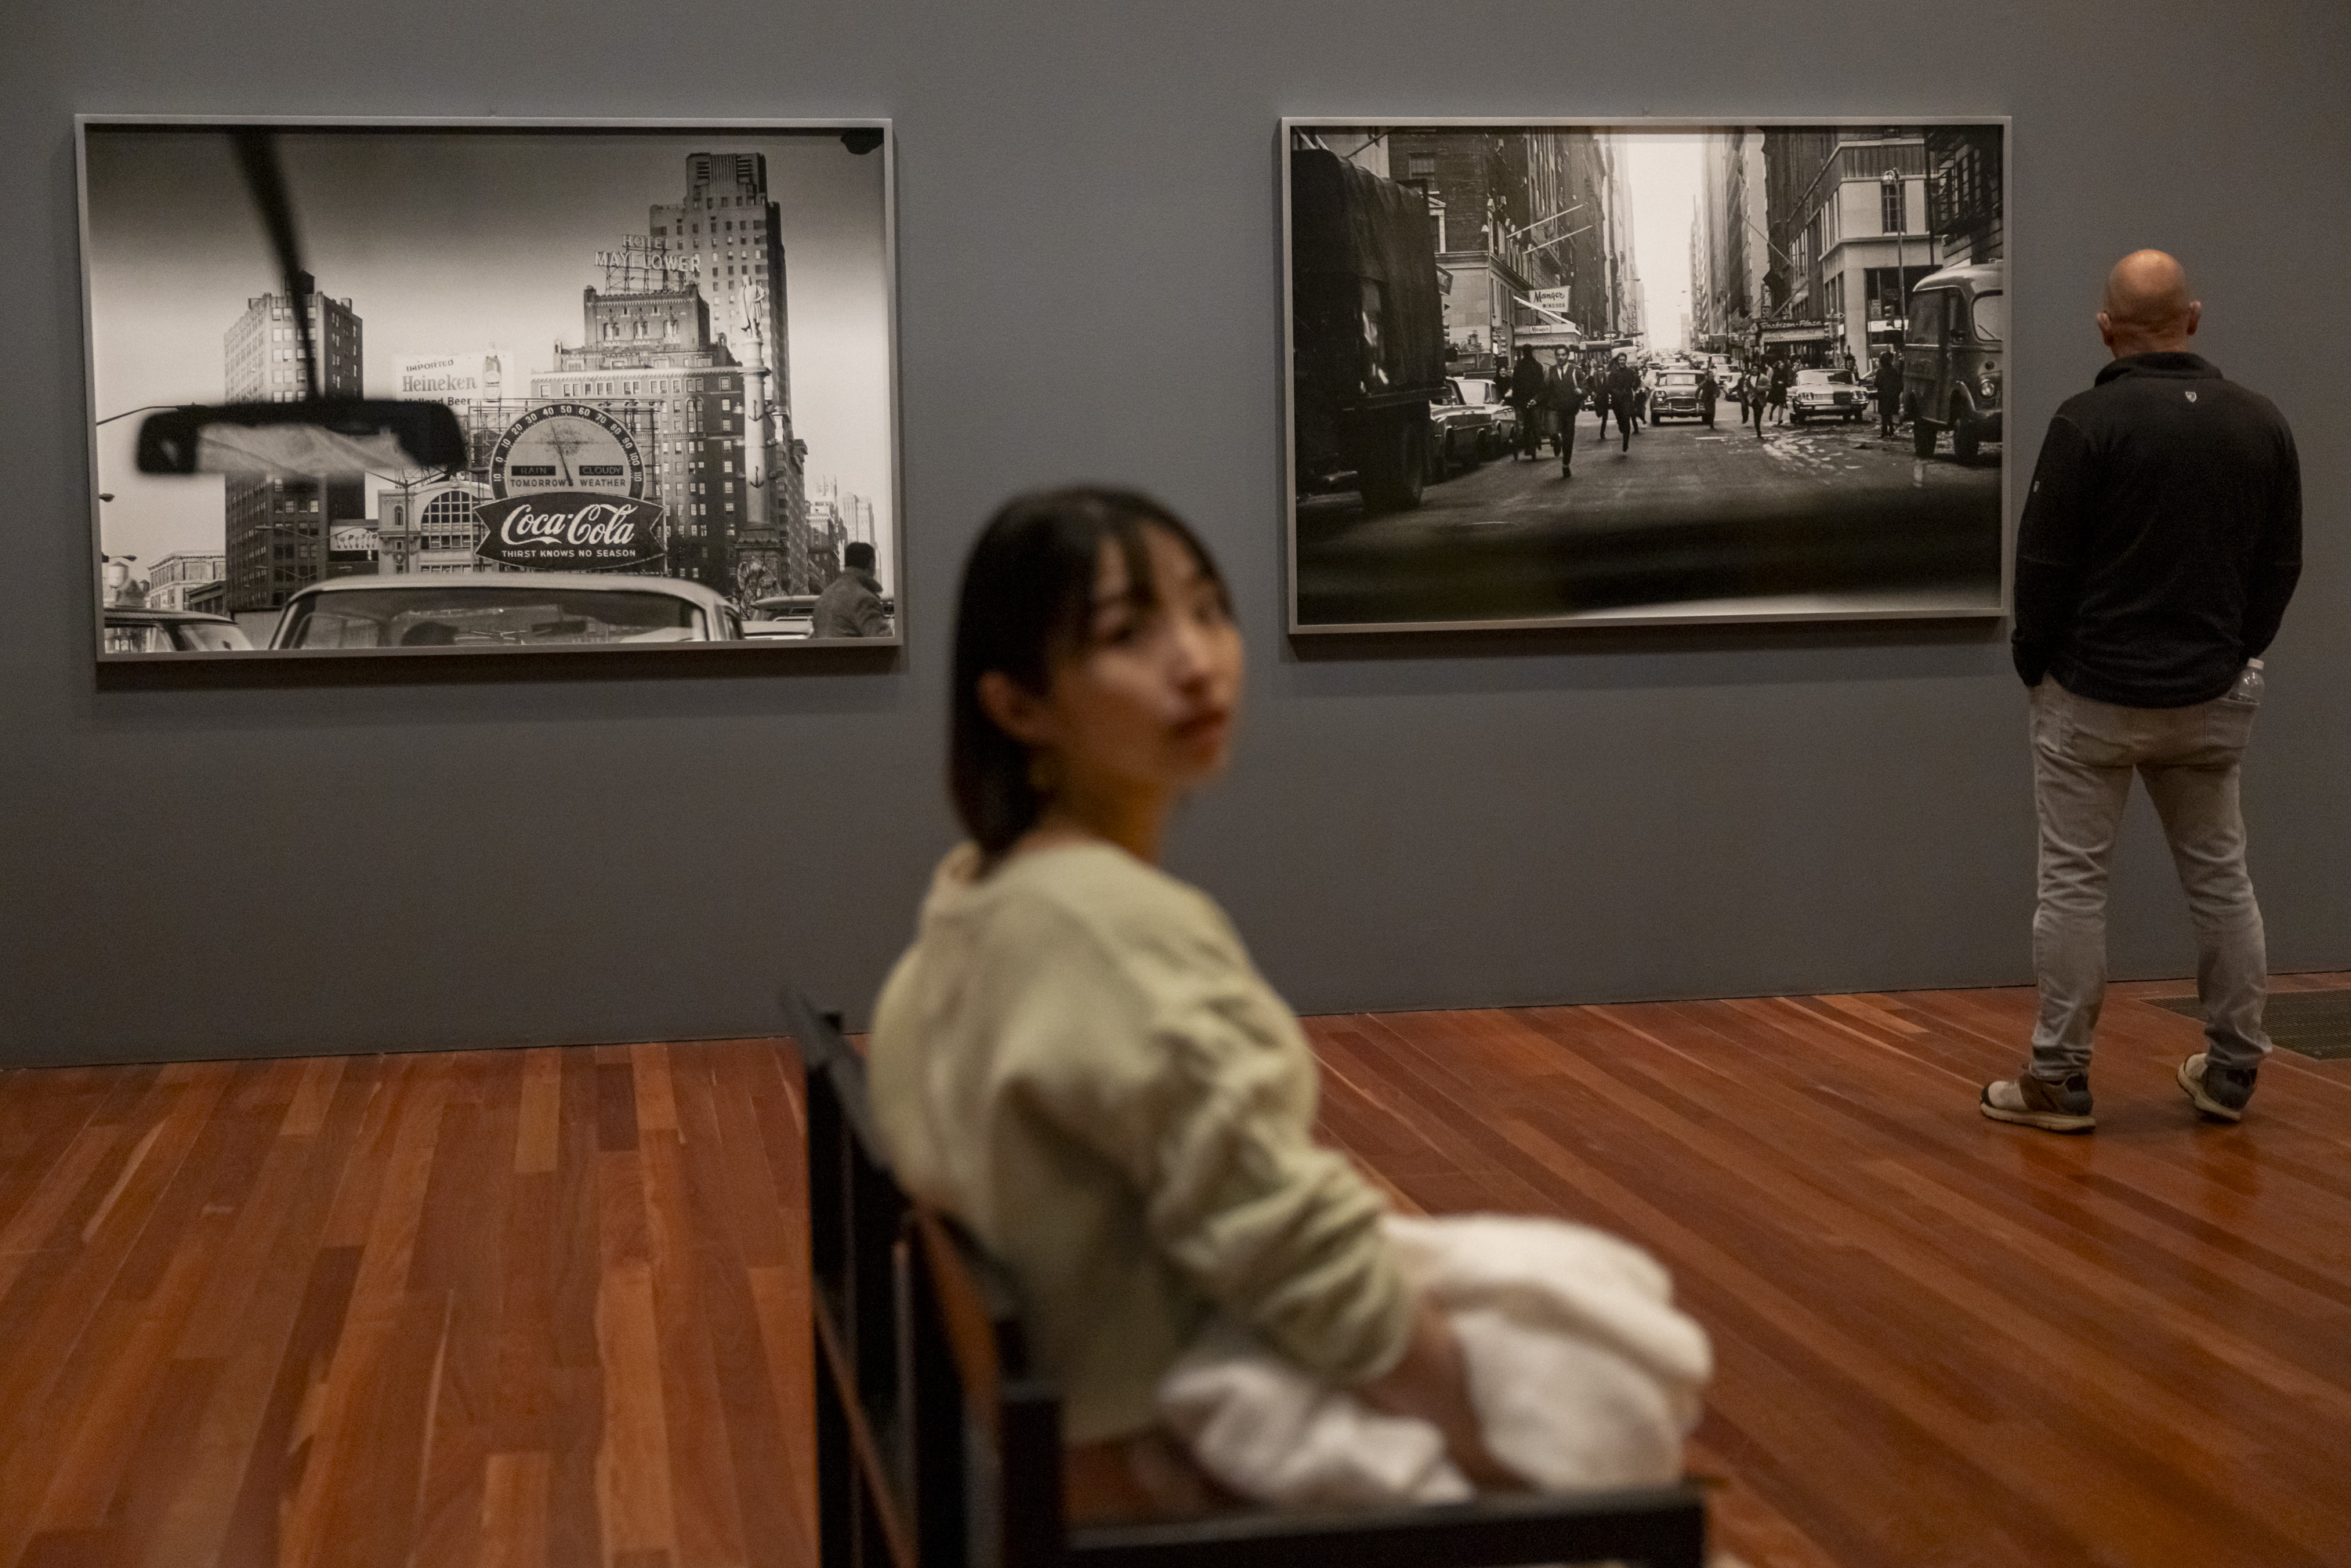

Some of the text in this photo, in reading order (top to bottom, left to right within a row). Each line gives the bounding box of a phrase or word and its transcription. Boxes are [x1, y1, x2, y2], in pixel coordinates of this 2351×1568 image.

[622, 234, 670, 249] HOTEL
[596, 251, 700, 272] MAYFLOWER
[1534, 291, 1565, 303] Manger
[406, 360, 454, 371] IMPORTED
[402, 375, 478, 392] Heineken
[447, 397, 472, 406] Beer
[542, 407, 554, 416] 40
[560, 405, 572, 414] 50
[578, 407, 590, 416] 60
[525, 413, 538, 424] 30
[596, 413, 607, 424] 70
[511, 423, 523, 435] 20
[610, 423, 622, 435] 80
[501, 438, 511, 448] 10
[621, 437, 633, 449] 90
[629, 452, 640, 466] 100
[520, 466, 547, 475] RAIN
[581, 466, 621, 475] CLOUDY
[493, 473, 502, 482] 10
[633, 472, 643, 482] 110
[510, 479, 574, 487] TOMORROWS
[501, 504, 639, 545] Coca-Cola
